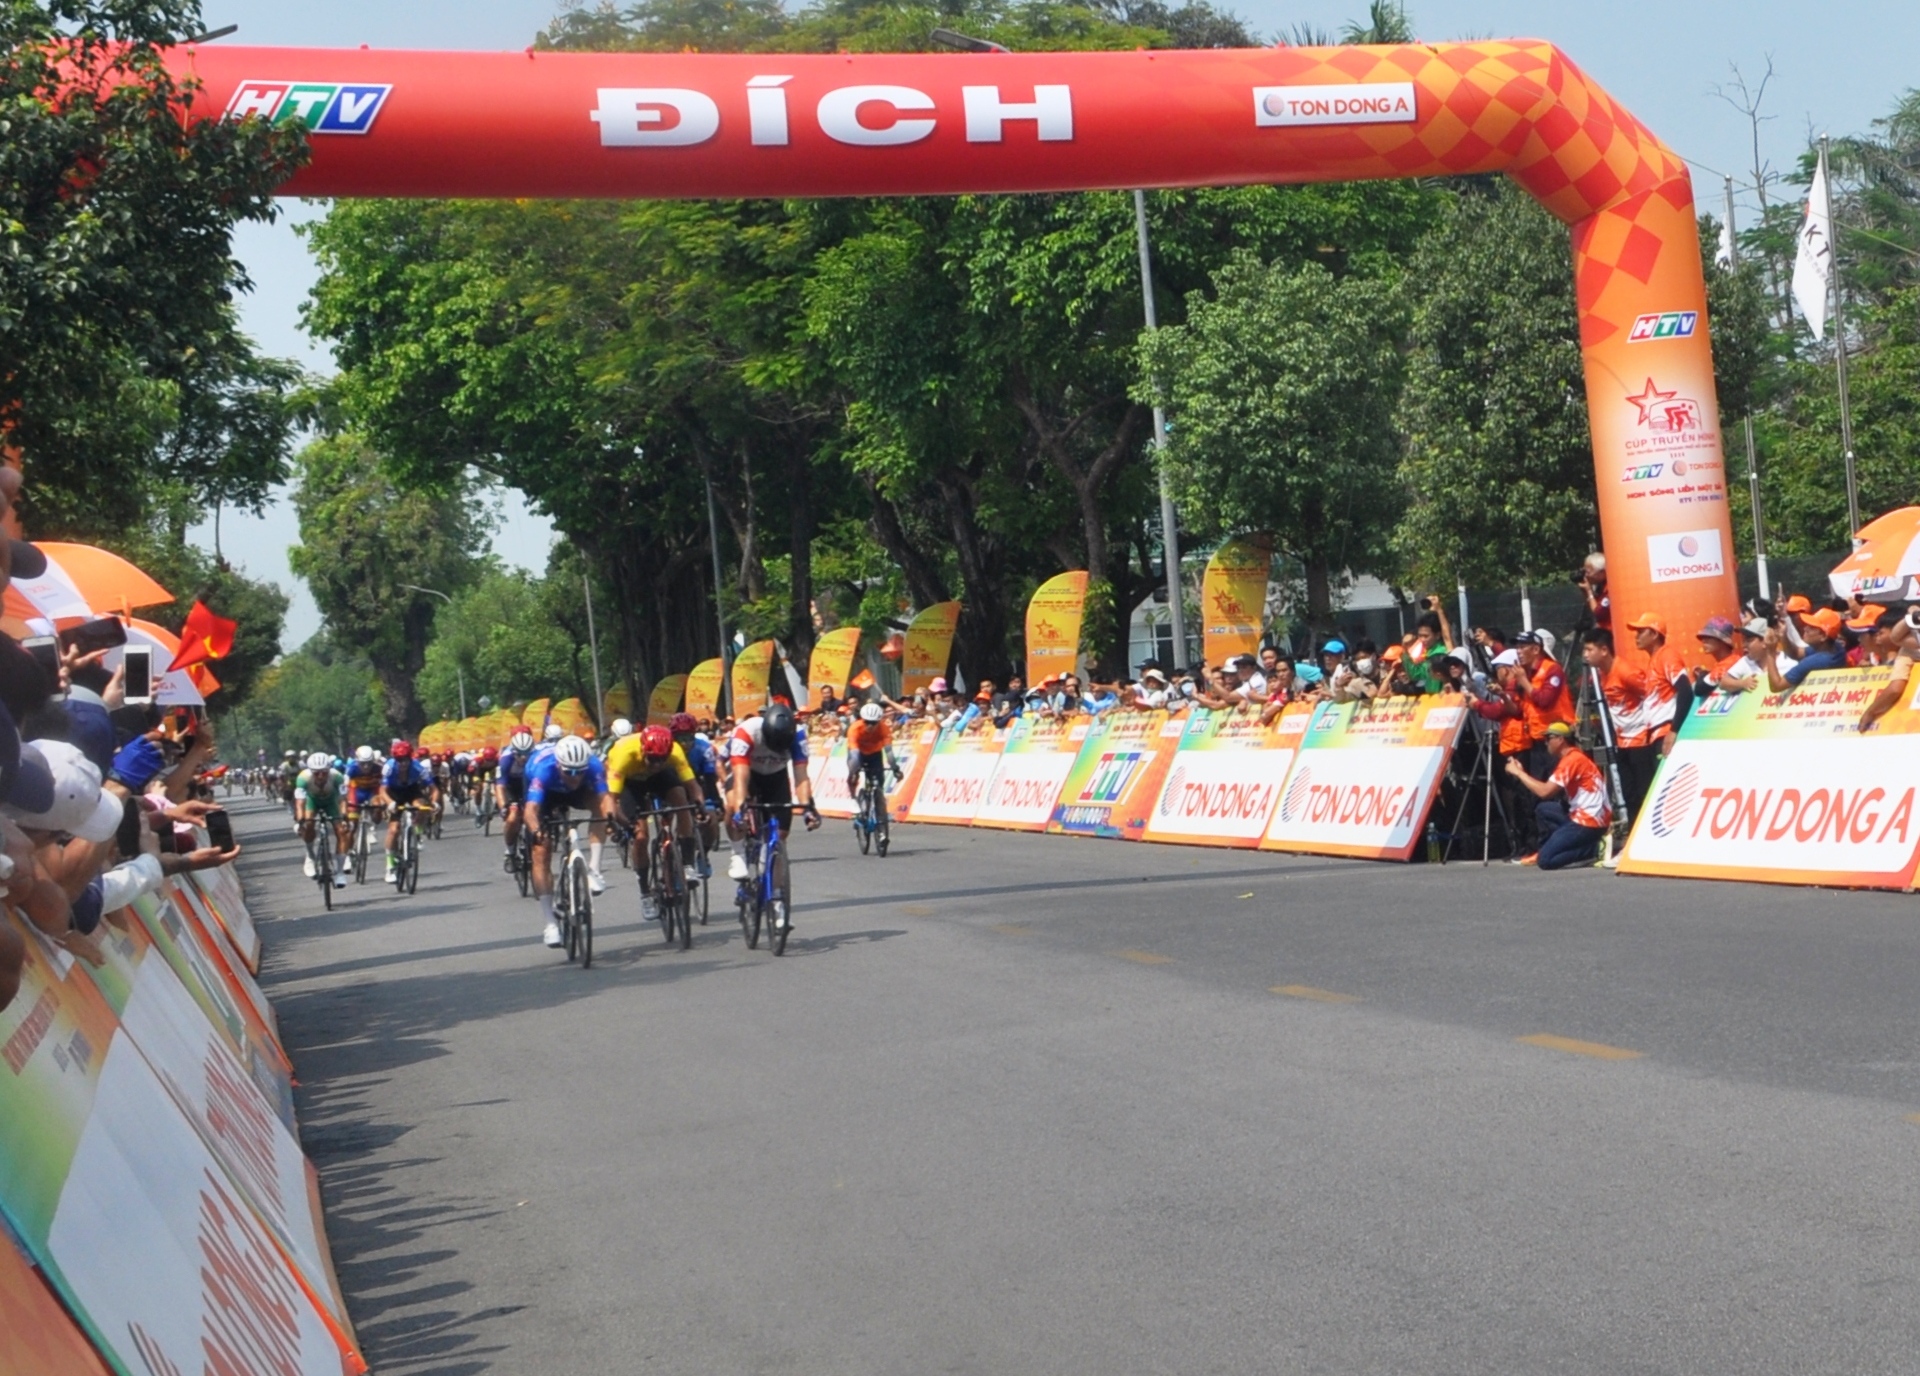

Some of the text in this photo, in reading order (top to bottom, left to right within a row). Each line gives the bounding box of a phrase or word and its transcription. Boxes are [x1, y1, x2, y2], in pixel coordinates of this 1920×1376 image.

[229, 88, 381, 125] HTV
[590, 75, 1074, 146] ĐÍCH
[1288, 97, 1409, 116] TON DONG A
[1630, 314, 1695, 339] HTV
[1622, 464, 1663, 481] HTV
[1656, 562, 1720, 577] TON DONG A
[996, 779, 1021, 806] TON
[1016, 780, 1052, 808] DONG
[1177, 783, 1273, 820] TON DONG A
[1301, 785, 1420, 828] TON DONG A
[1691, 787, 1916, 844] TON DONG A
